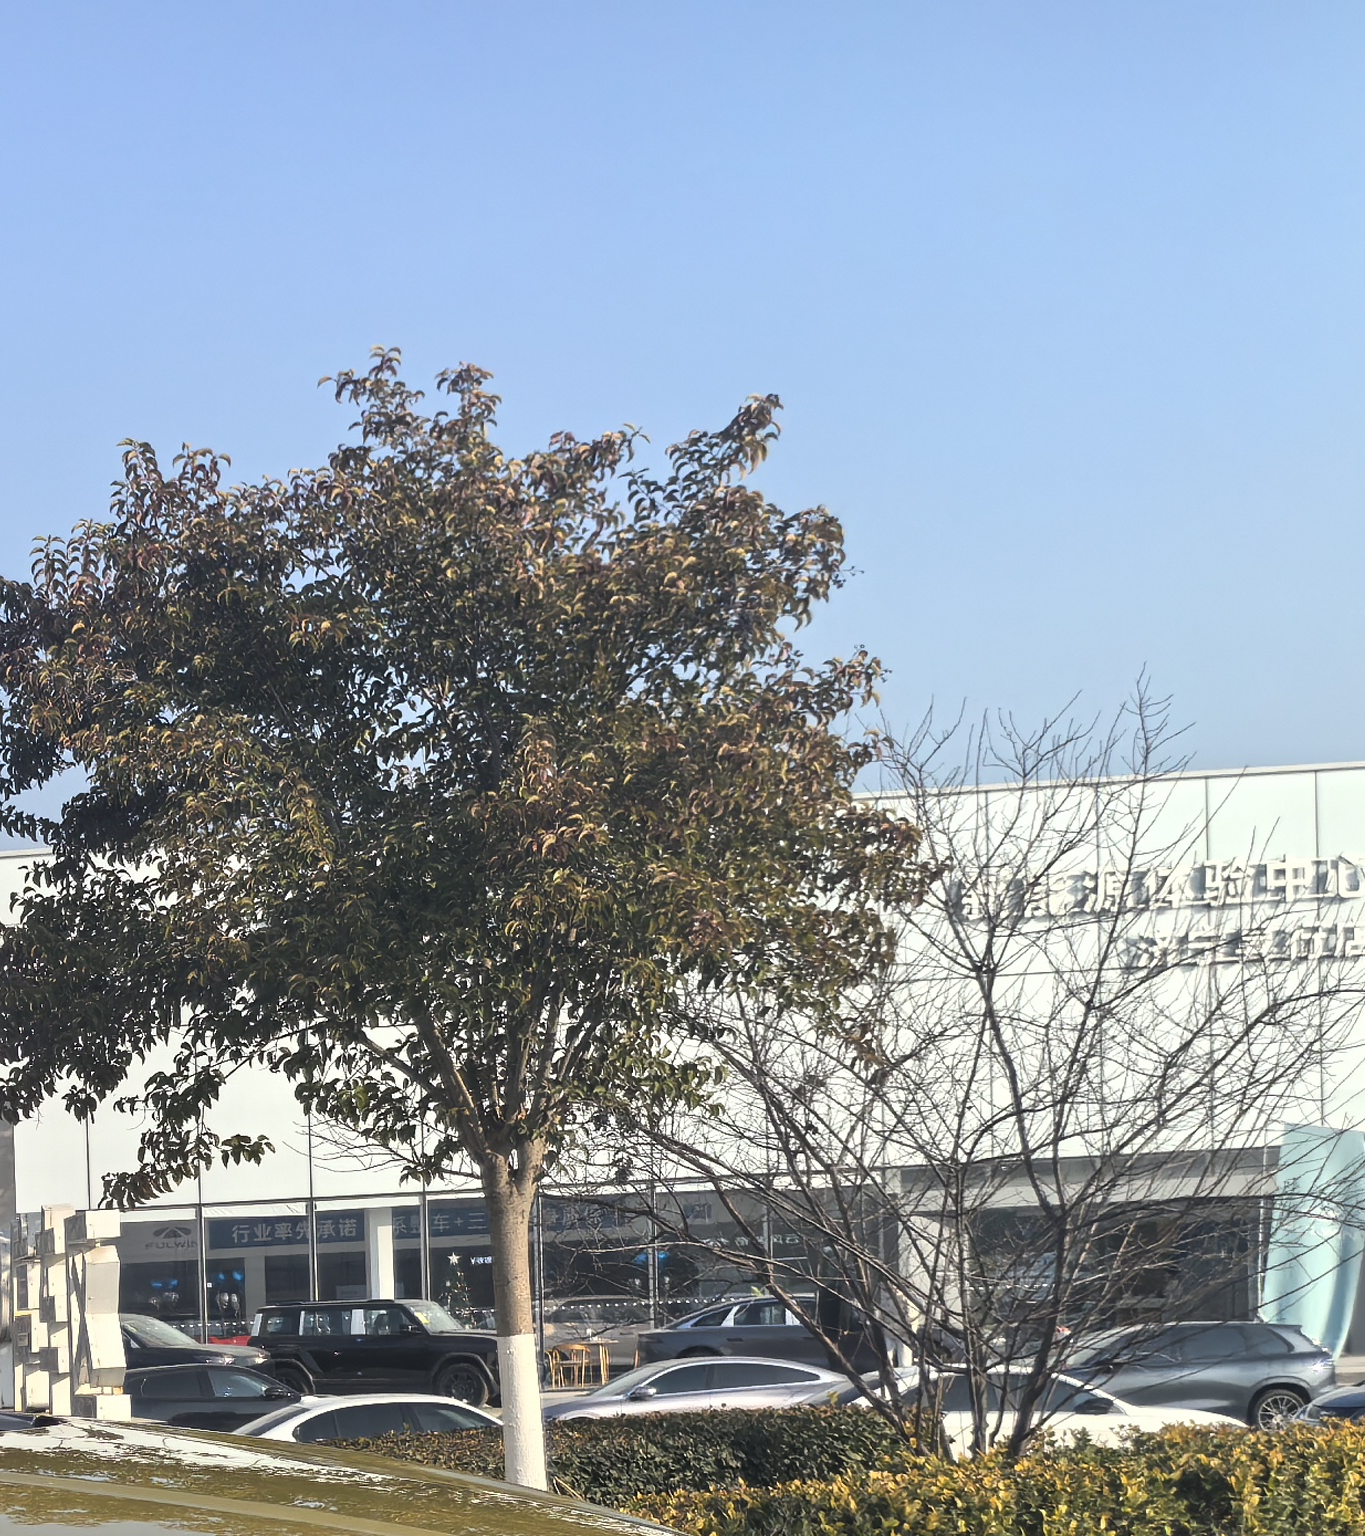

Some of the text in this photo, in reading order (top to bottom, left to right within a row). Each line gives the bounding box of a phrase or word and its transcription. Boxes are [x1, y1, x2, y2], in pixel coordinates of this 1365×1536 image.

[231, 1218, 357, 1244] 行业率先承诺
